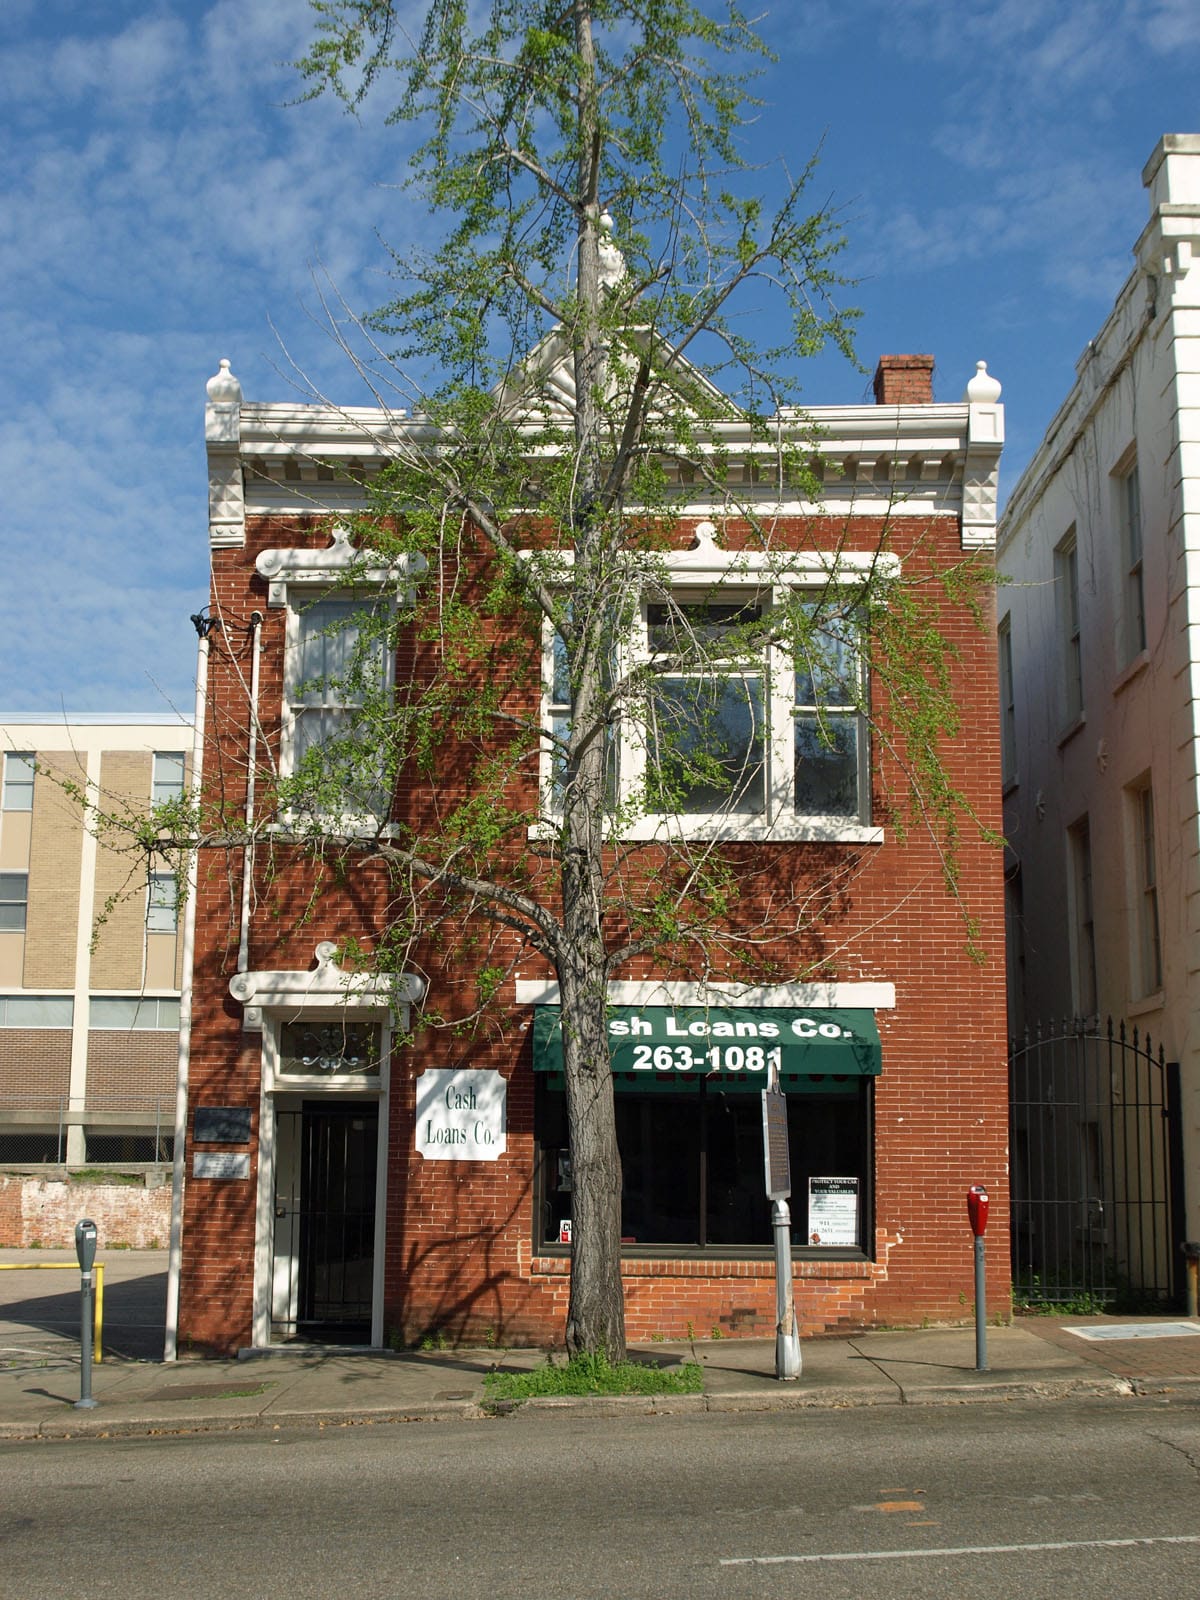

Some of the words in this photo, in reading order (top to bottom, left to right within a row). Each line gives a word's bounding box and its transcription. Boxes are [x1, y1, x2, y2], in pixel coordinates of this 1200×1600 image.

[666, 1016, 780, 1038] Loans
[791, 1018, 853, 1038] Co.
[632, 1045, 782, 1071] 263-1081
[446, 1085, 477, 1110] Cash
[427, 1119, 467, 1145] Loans
[474, 1120, 495, 1145] Co.
